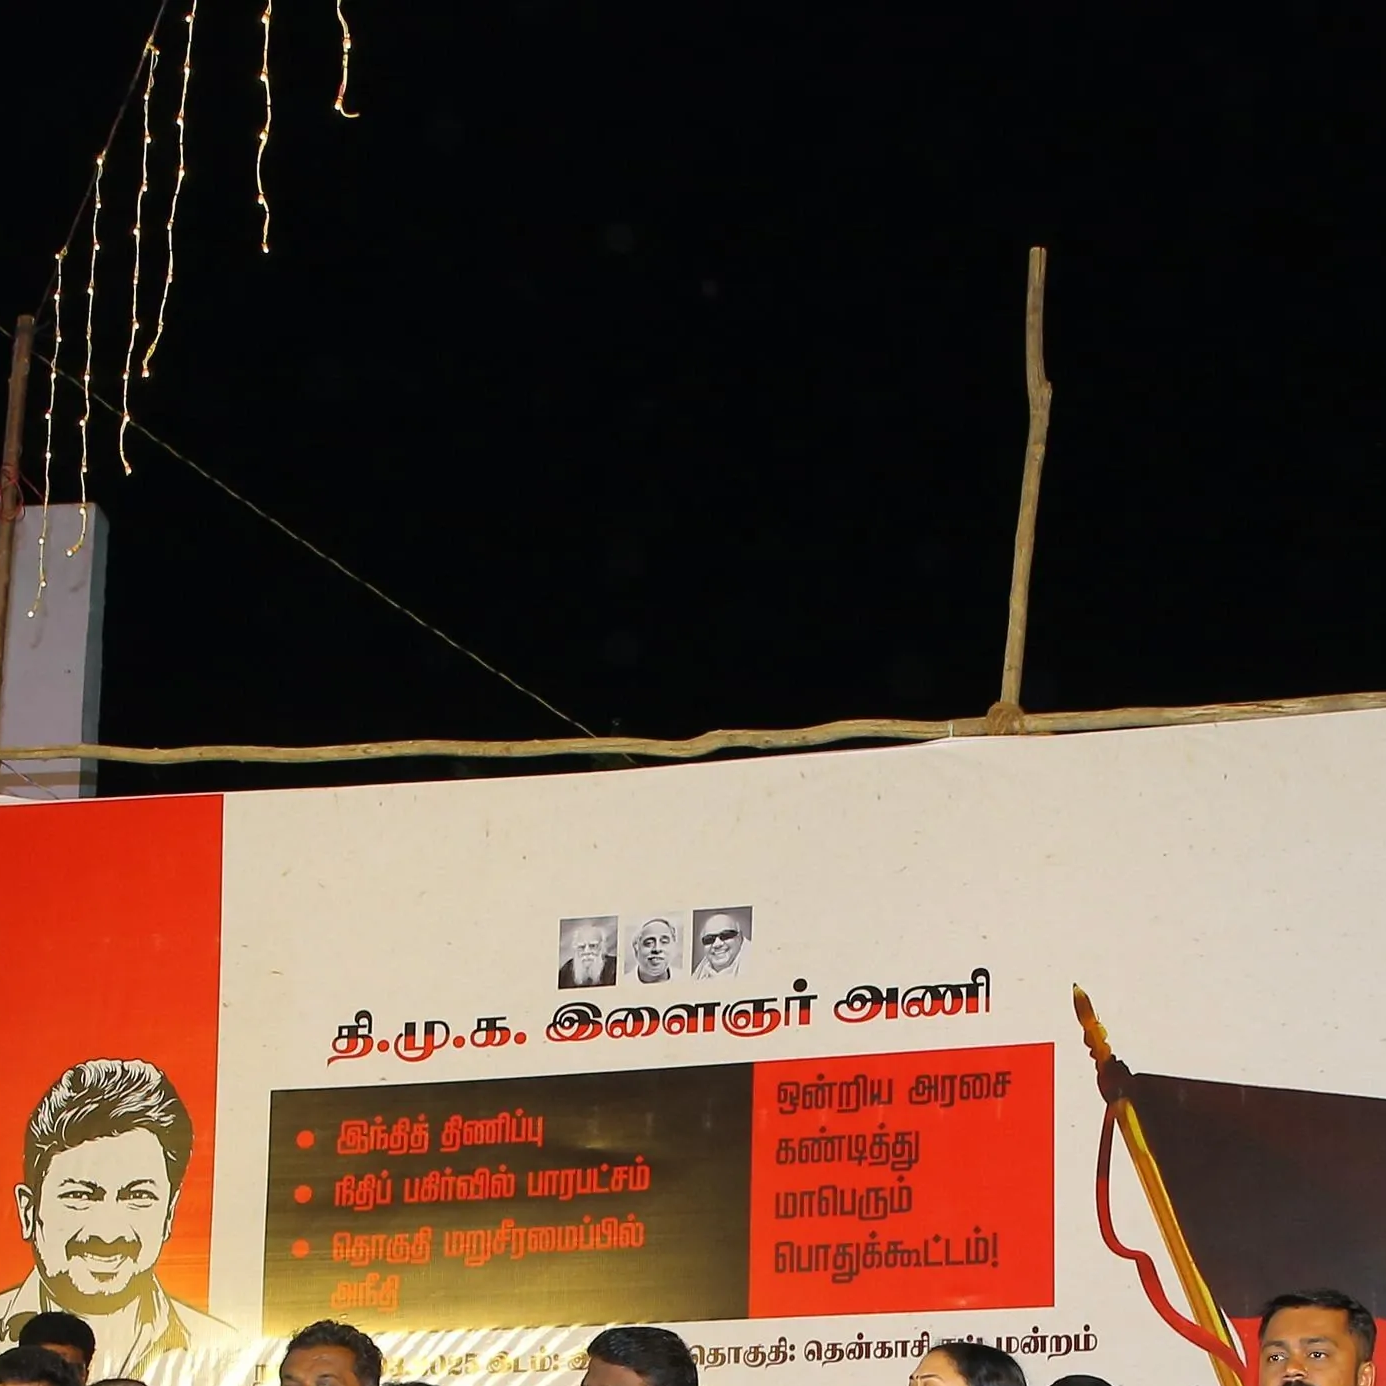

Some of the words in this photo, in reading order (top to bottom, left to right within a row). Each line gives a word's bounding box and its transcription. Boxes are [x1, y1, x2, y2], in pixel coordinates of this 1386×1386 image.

[326, 1009, 528, 1068] தி.மு.க.
[545, 977, 819, 1042] இளைஞர்
[833, 967, 991, 1024] அணி
[776, 1072, 894, 1115] ஒன்றிய
[908, 1070, 1012, 1109] அரசை
[337, 1112, 430, 1155] இந்தித்
[439, 1107, 544, 1153] திணிப்பு
[775, 1121, 921, 1172] கண்டித்து
[333, 1169, 392, 1212] நிதிப்
[403, 1163, 516, 1205] பகிர்வில்
[527, 1154, 652, 1201] பாரபட்சம்
[775, 1174, 913, 1222] மாபெரும்
[332, 1226, 433, 1267] தொகுதி
[443, 1212, 646, 1268] மறுசீரமைப்பில்
[774, 1224, 999, 1285] பொதுக்கூட்டம்!
[330, 1272, 401, 1313] அநீதி
[803, 1331, 930, 1367] தென்காசி
